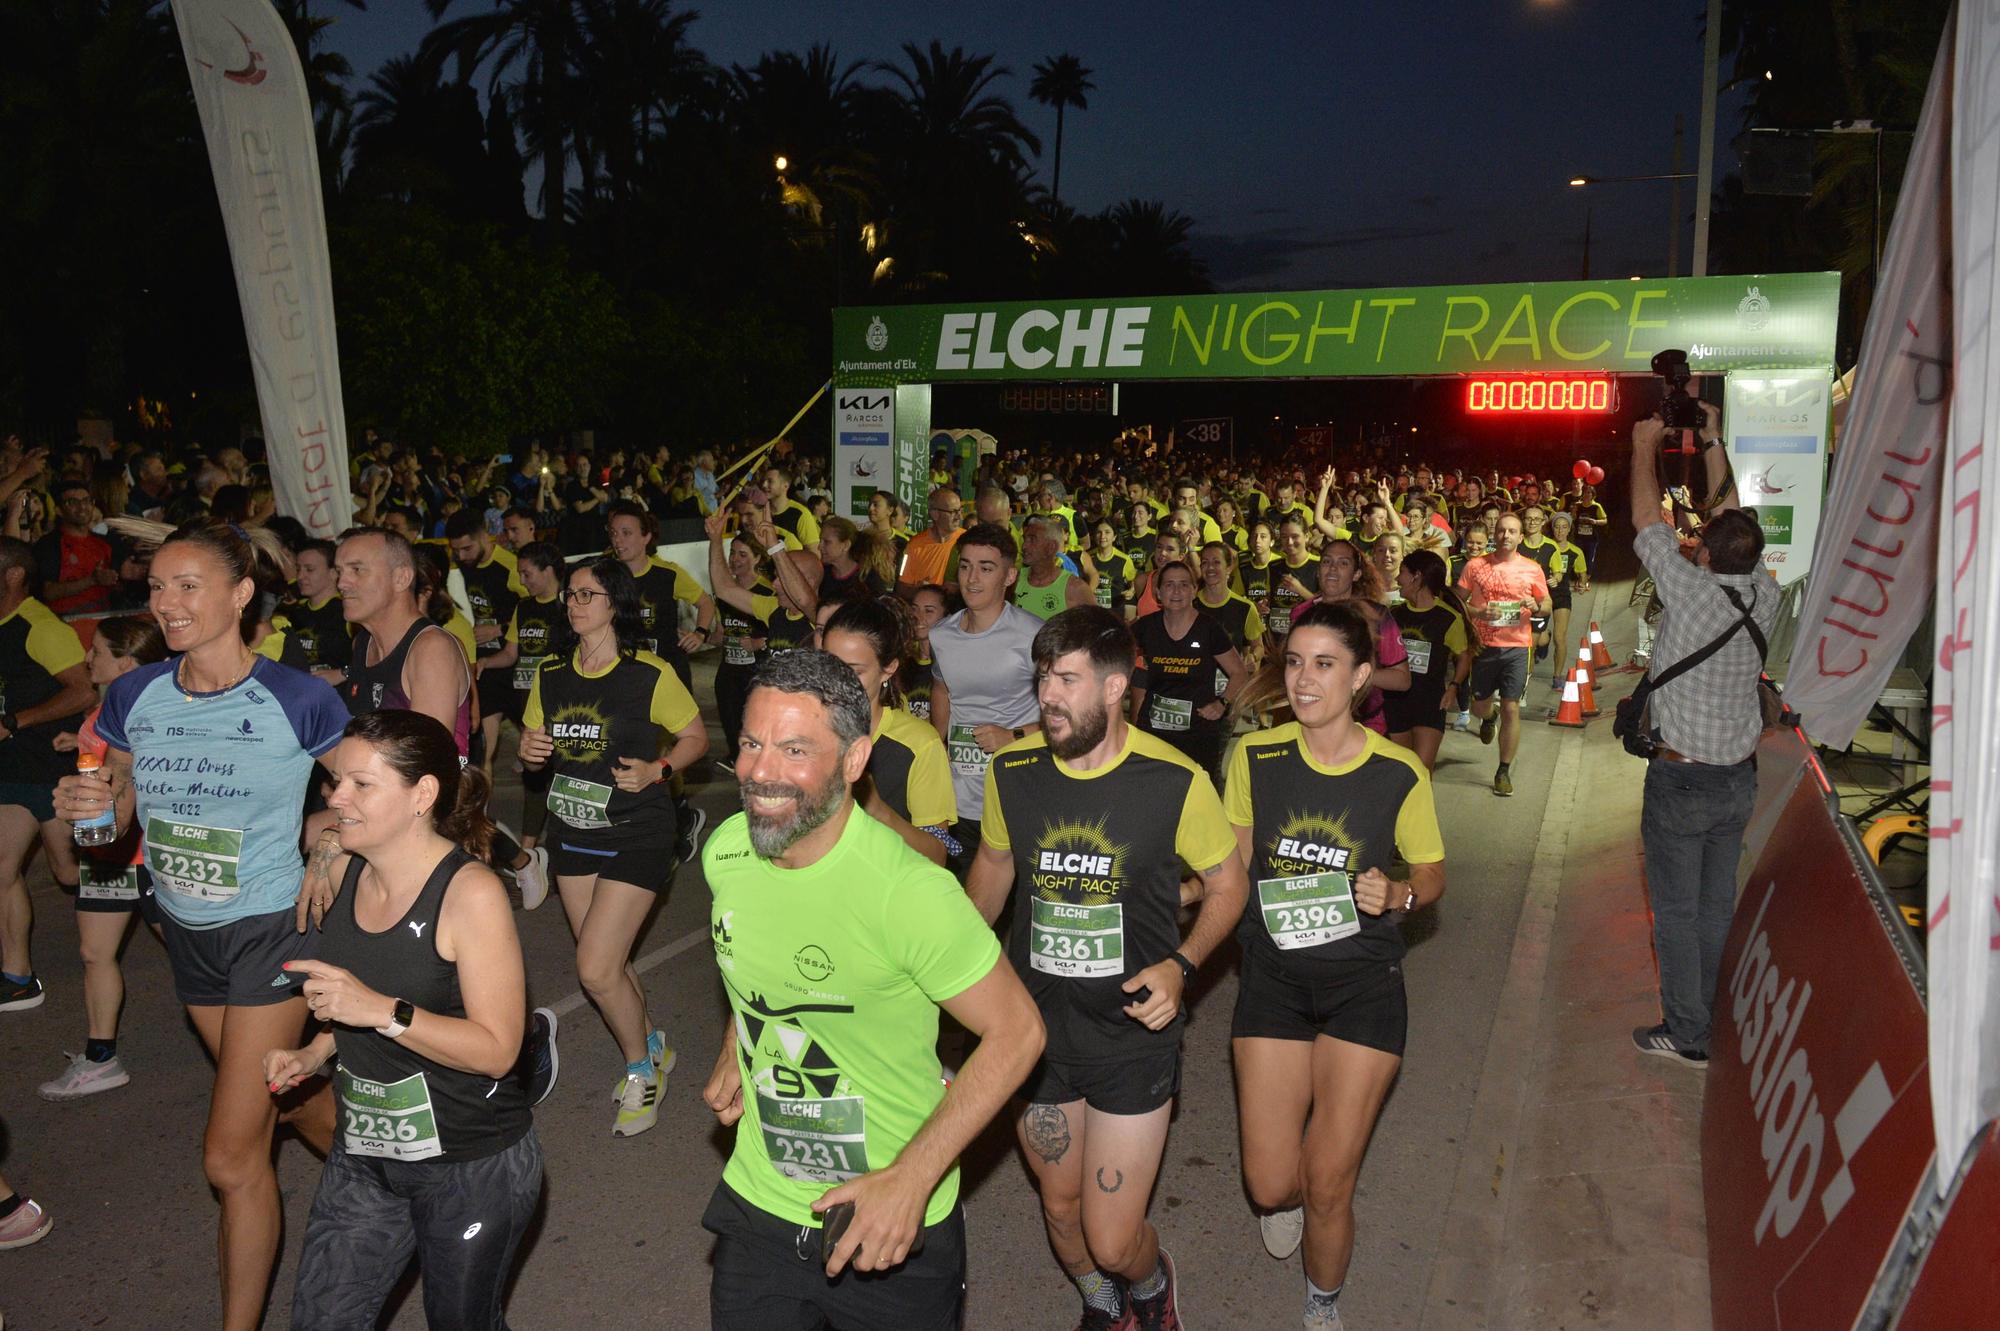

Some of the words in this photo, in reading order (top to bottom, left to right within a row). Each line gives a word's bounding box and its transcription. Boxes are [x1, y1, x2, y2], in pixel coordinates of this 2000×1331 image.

[935, 306, 1151, 370] ELCHE
[1170, 297, 1416, 366] NIGHT
[1437, 289, 1668, 362] RACE
[1689, 343, 1775, 359] Ajuntament
[839, 359, 892, 372] Ajuntament
[894, 358, 917, 370] d'Elx
[840, 396, 890, 409] KIA
[1152, 656, 1201, 666] RICOPOLLO
[1408, 654, 1422, 664] 76
[1163, 665, 1189, 674] TEAM
[1153, 710, 1184, 725] 2110
[166, 726, 184, 737] ns
[552, 723, 600, 739] ELCHE
[962, 727, 973, 735] ELC
[580, 740, 608, 751] RACE
[1004, 758, 1030, 768] luanvi
[1256, 751, 1280, 760] luanvi
[135, 756, 193, 772] XXXVII
[196, 757, 238, 776] Cross
[568, 780, 590, 792] ELCHE
[172, 803, 201, 816] 2022
[556, 799, 598, 820] 2182
[172, 825, 209, 840] ELCHE
[715, 851, 742, 861] luanvi
[1276, 838, 1349, 868] ELCHE
[160, 852, 224, 885] 2232
[1039, 851, 1112, 876] ELCHE
[1268, 856, 1313, 875] NIGHT
[1032, 873, 1077, 891] NIGHT
[1080, 877, 1121, 896] RACE
[1285, 878, 1319, 891] ELCHE
[1053, 906, 1090, 919] ELCHE
[1277, 904, 1343, 932] 2396
[1040, 934, 1104, 960] 2361
[793, 954, 835, 973] NISSAN
[784, 981, 808, 996] GRUPO
[808, 988, 846, 1001] MARCOS
[764, 1045, 783, 1061] LA
[1729, 880, 1825, 1248] lastlap
[352, 1079, 386, 1097] ELCHE
[779, 1103, 822, 1118] ELCHE
[345, 1109, 418, 1142] 2236
[776, 1137, 851, 1170] 2231
